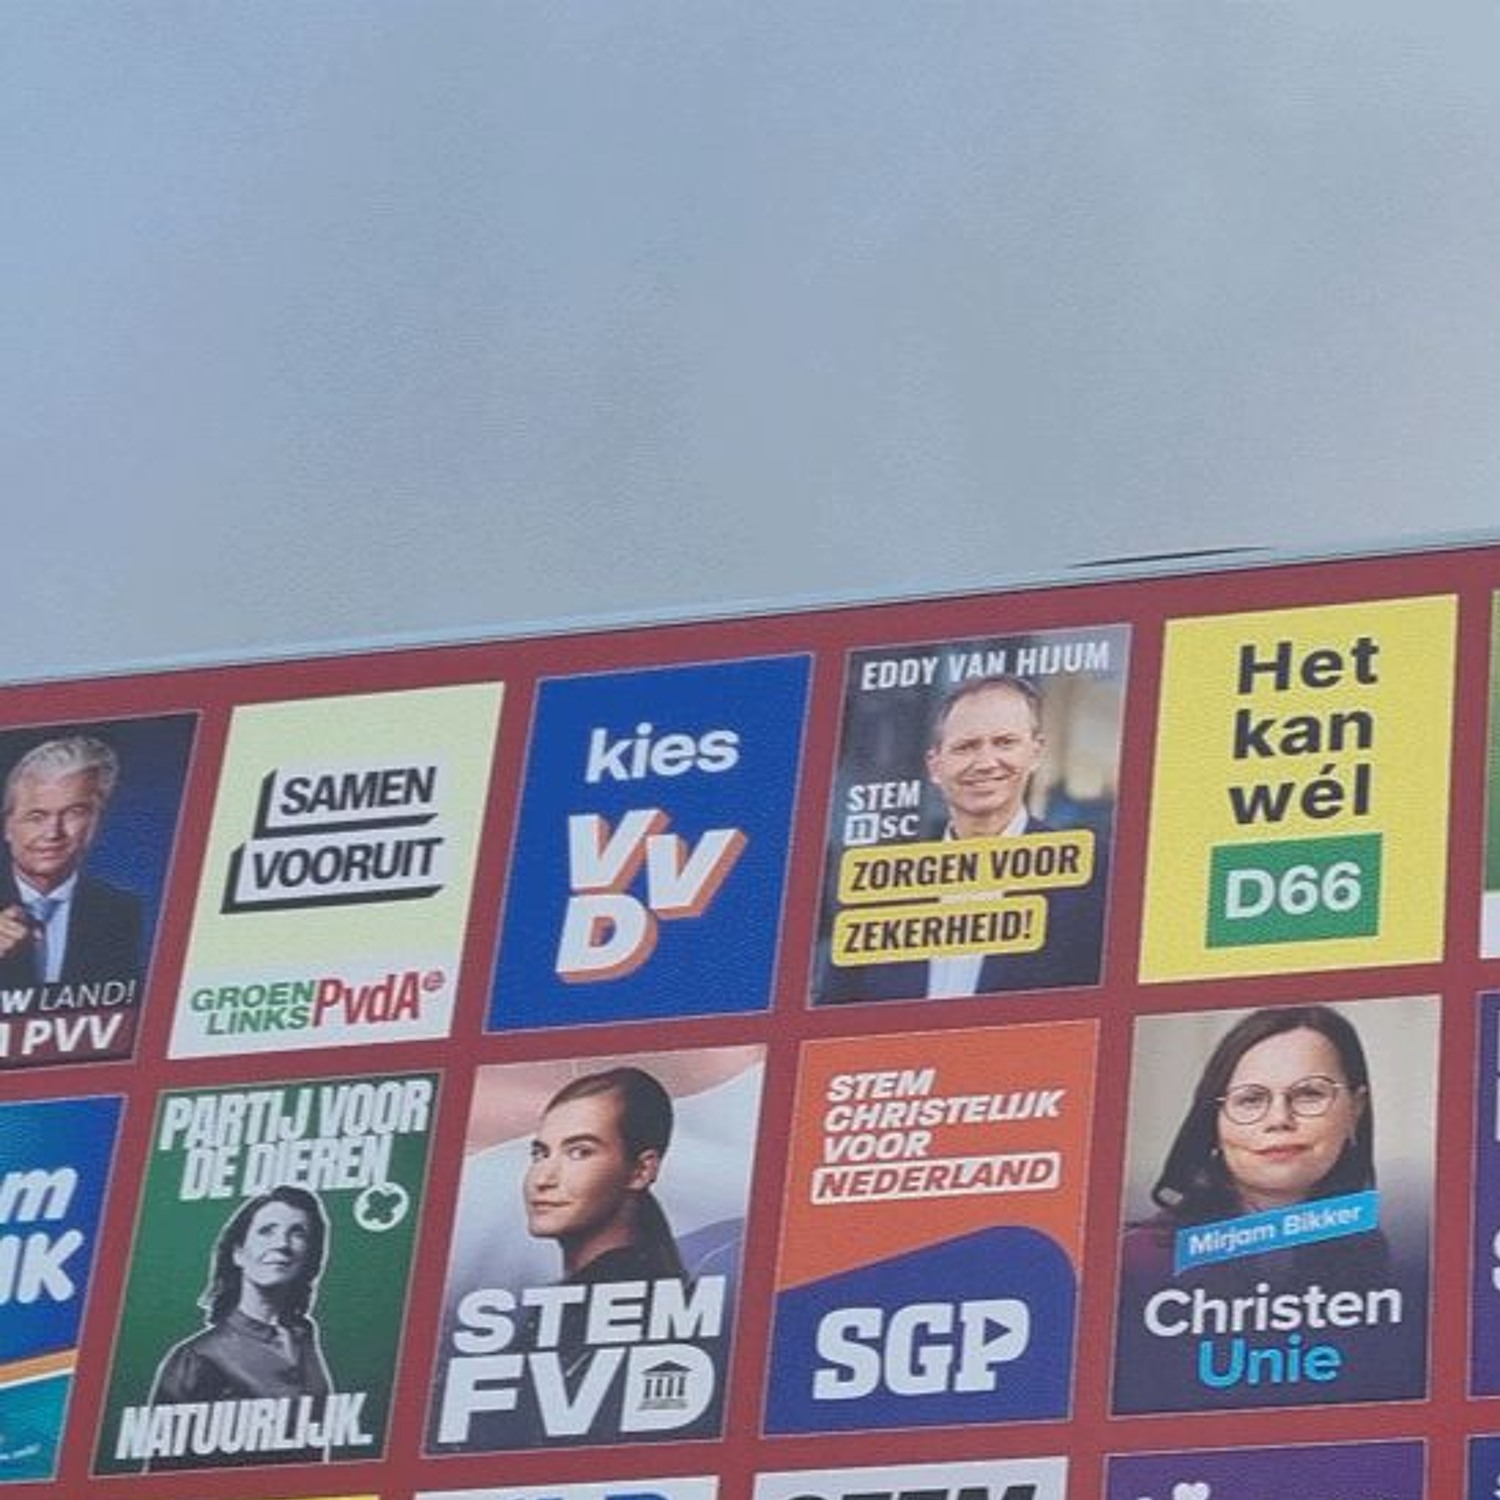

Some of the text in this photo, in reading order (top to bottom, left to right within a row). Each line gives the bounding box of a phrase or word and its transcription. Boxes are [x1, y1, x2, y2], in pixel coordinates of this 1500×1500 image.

[861, 640, 1111, 692] EDDY VAN HIJUM
[1238, 636, 1379, 694] Het
[584, 721, 742, 784] kies
[1232, 708, 1374, 760] kan
[279, 766, 437, 817] SAMEN
[845, 779, 921, 812] STEM
[1228, 762, 1373, 825] wél
[252, 836, 445, 891] VOORUIT
[850, 843, 1082, 892] ZORGEN VOOR
[1224, 860, 1363, 919] D66
[843, 909, 1036, 955] ZEKERHEID!
[39, 979, 137, 1012] LAND!
[190, 979, 315, 1013] GROEN
[205, 1006, 311, 1037] LINKS
[21, 1012, 124, 1056] PVV
[826, 1068, 937, 1102] STEM
[158, 1080, 434, 1152] PARTIJ VOOR
[823, 1089, 1066, 1134] CHRISTELIJK
[178, 1134, 395, 1202] DE DIEREN
[822, 1129, 932, 1165] VOOR
[817, 1158, 1055, 1200] NEDERLAND
[1186, 1201, 1364, 1258] Mirjam Bikker
[454, 1274, 727, 1355] STEM
[1143, 1283, 1402, 1337] Christen
[812, 1299, 1032, 1401] SGP
[1197, 1333, 1342, 1388] Unie
[436, 1344, 716, 1445] FVD
